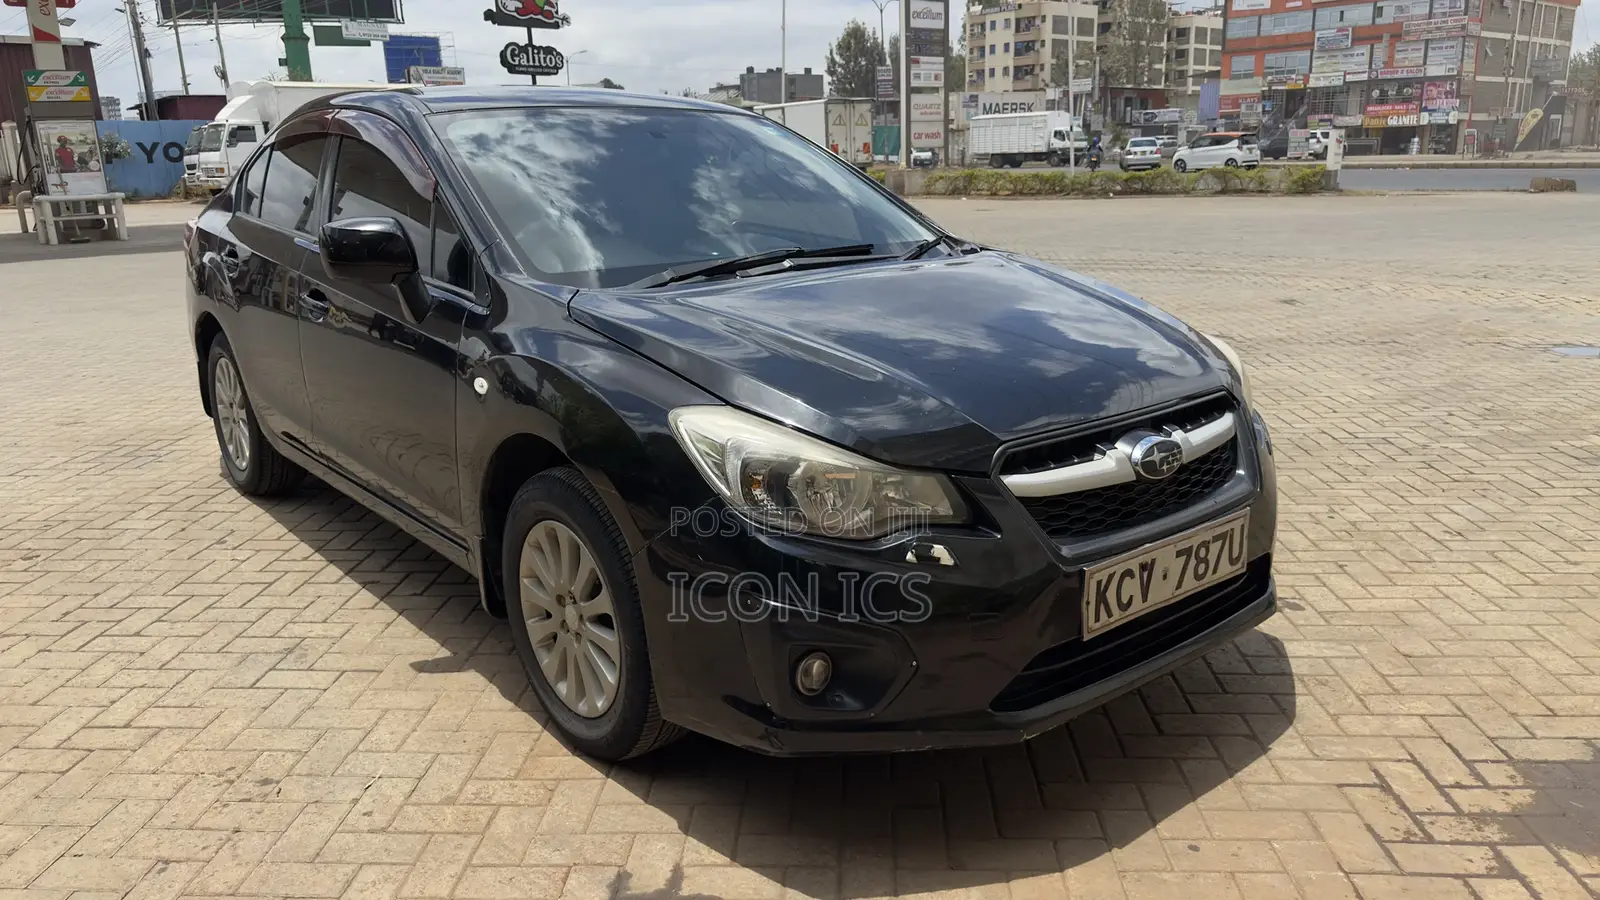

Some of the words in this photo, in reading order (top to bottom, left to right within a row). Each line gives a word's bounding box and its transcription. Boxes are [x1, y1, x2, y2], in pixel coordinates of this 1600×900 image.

[506, 45, 563, 68] Galito's
[982, 102, 1035, 115] MAERSK
[1387, 114, 1418, 125] GRANITE
[913, 132, 923, 140] car
[924, 129, 942, 140] wash
[1094, 558, 1156, 624] KCV
[1174, 523, 1245, 592] 787U
